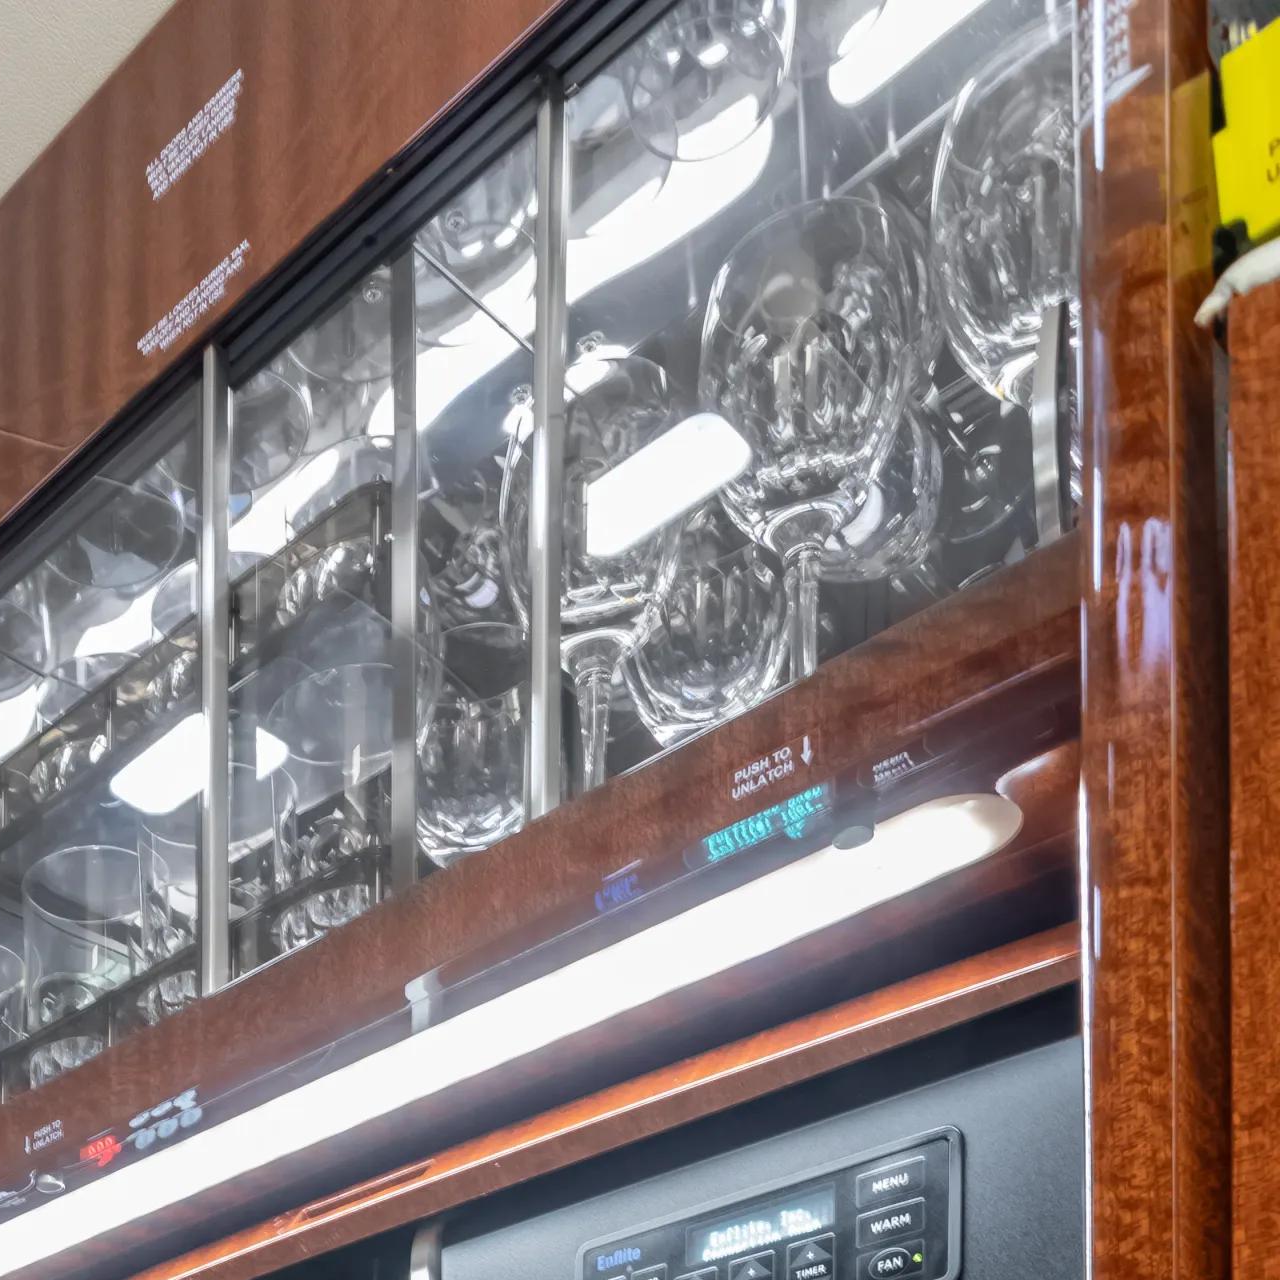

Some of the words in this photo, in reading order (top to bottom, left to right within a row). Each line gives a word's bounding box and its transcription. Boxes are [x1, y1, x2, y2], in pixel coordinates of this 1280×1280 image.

[146, 158, 160, 176] ALL
[160, 127, 186, 160] DOORS
[187, 110, 203, 133] AND
[204, 68, 242, 113] DRAWERS
[147, 159, 168, 184] MUST
[168, 146, 180, 162] BE
[179, 114, 210, 150] CLOSED
[210, 82, 240, 117] DURING
[201, 98, 235, 139] LANDING
[152, 180, 169, 200] AND
[169, 155, 192, 183] WHEN
[192, 138, 208, 159] NOT
[208, 129, 218, 142] IN
[218, 110, 235, 132] USE
[136, 324, 156, 350] MUST
[157, 315, 168, 330] BE
[168, 286, 199, 320] LOCKED
[200, 256, 230, 290] DURING
[141, 321, 174, 356] TAKEOFF
[174, 305, 191, 326] AND
[191, 272, 225, 309] LANDING
[225, 256, 244, 278] AND
[159, 326, 183, 352] WHEN
[182, 309, 199, 330] NOT
[199, 301, 208, 314] IN
[208, 284, 226, 306] USE
[732, 760, 795, 800] UNLATCH
[733, 757, 770, 784] PUSH
[771, 746, 792, 767] TO
[32, 1129, 64, 1151] UNLATCH
[33, 1125, 52, 1140] PUSH
[51, 1119, 62, 1131] TO
[872, 1172, 909, 1194] MENU
[870, 1212, 911, 1235] WARM
[596, 1247, 641, 1271] Enflite
[795, 1264, 827, 1280] TIMER
[877, 1256, 903, 1274] FAN
